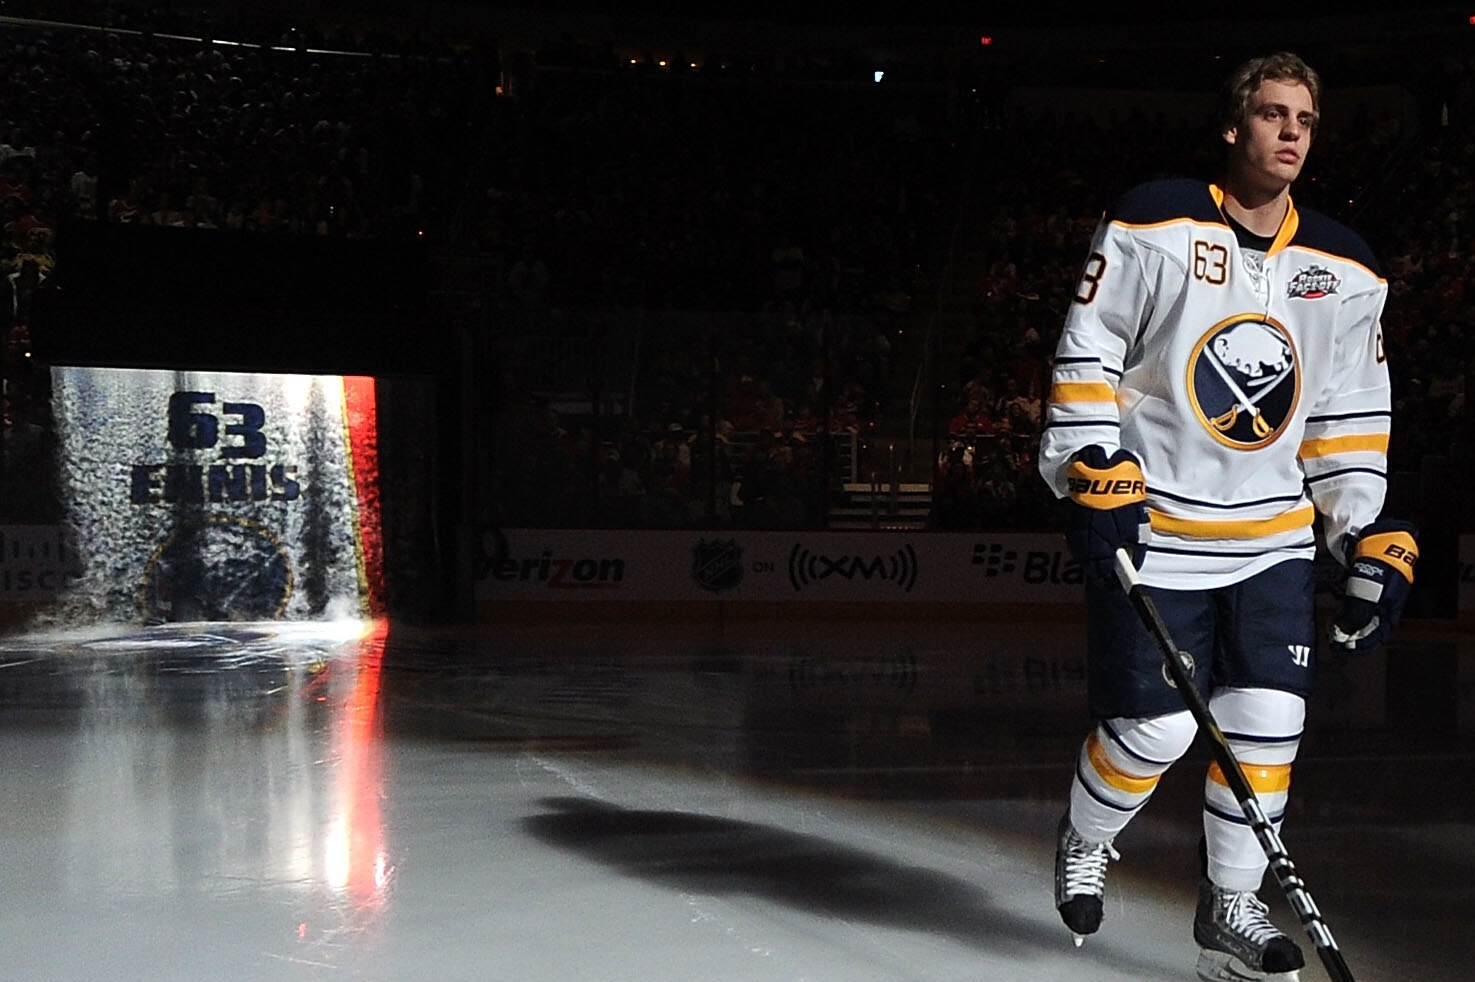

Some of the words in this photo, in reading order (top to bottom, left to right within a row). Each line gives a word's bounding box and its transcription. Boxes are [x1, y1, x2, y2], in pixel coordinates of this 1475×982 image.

[1195, 241, 1227, 285] 63
[168, 390, 266, 458] 63
[131, 464, 301, 503] ENNIS
[752, 561, 774, 573] ON
